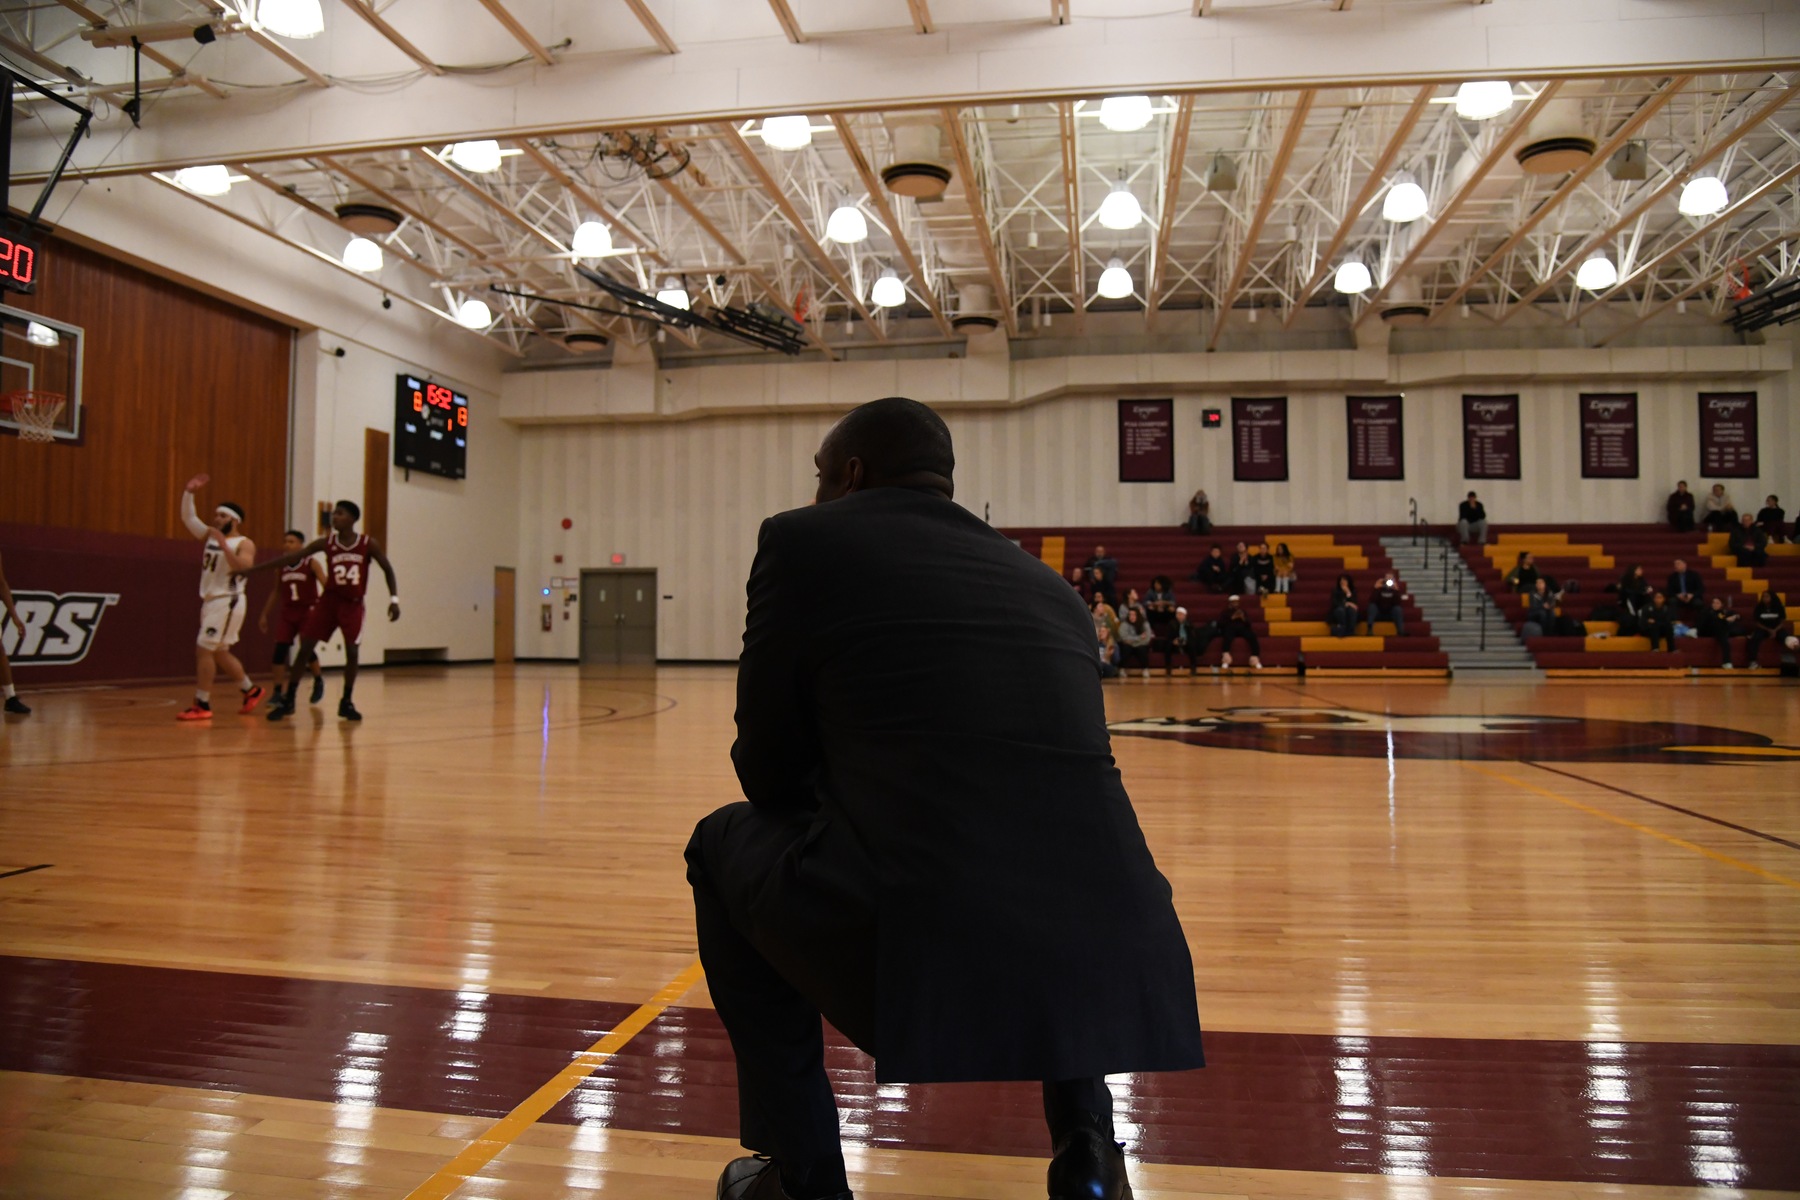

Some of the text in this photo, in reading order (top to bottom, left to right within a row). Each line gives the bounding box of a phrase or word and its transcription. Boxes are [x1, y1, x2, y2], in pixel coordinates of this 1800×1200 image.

[333, 565, 360, 585] 24
[290, 583, 299, 601] 1
[0, 596, 102, 660] RS
